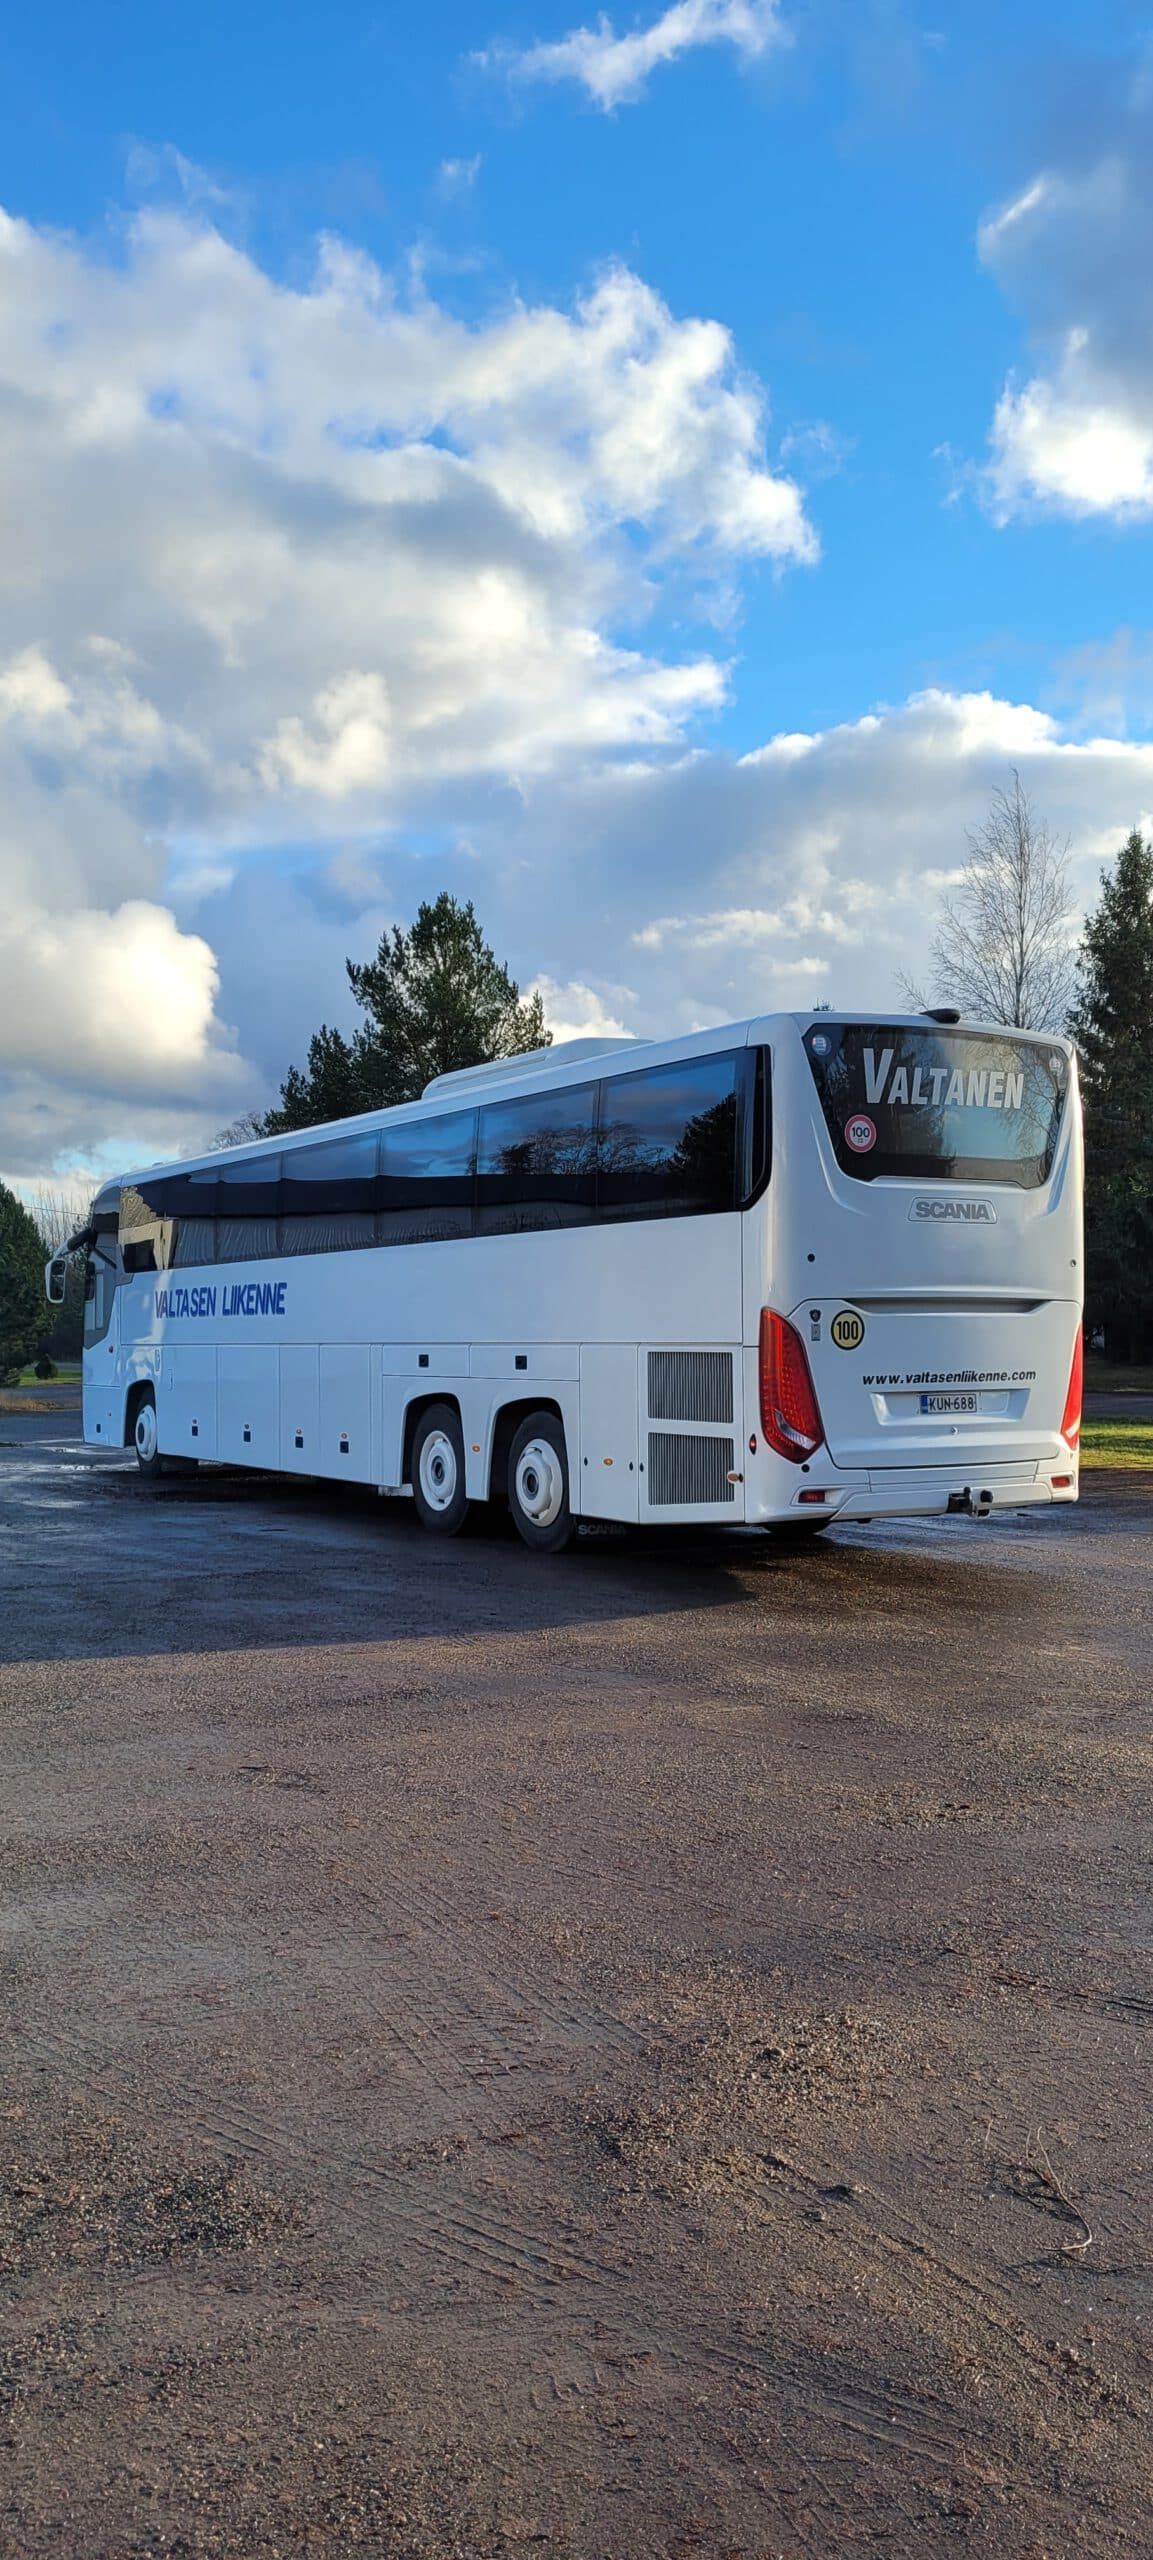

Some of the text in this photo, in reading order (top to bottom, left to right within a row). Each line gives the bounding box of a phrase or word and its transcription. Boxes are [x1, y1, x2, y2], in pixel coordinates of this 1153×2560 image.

[863, 1047, 1024, 1109] VALTANEN
[852, 1127, 870, 1138] 100
[915, 1201, 990, 1220] SCANIA
[154, 1282, 287, 1318] VALTASEN LIIKENNE
[836, 1320, 859, 1340] 100
[862, 1370, 1036, 1385] www.valtasenliikenne.com
[929, 1397, 974, 1411] KUN-688
